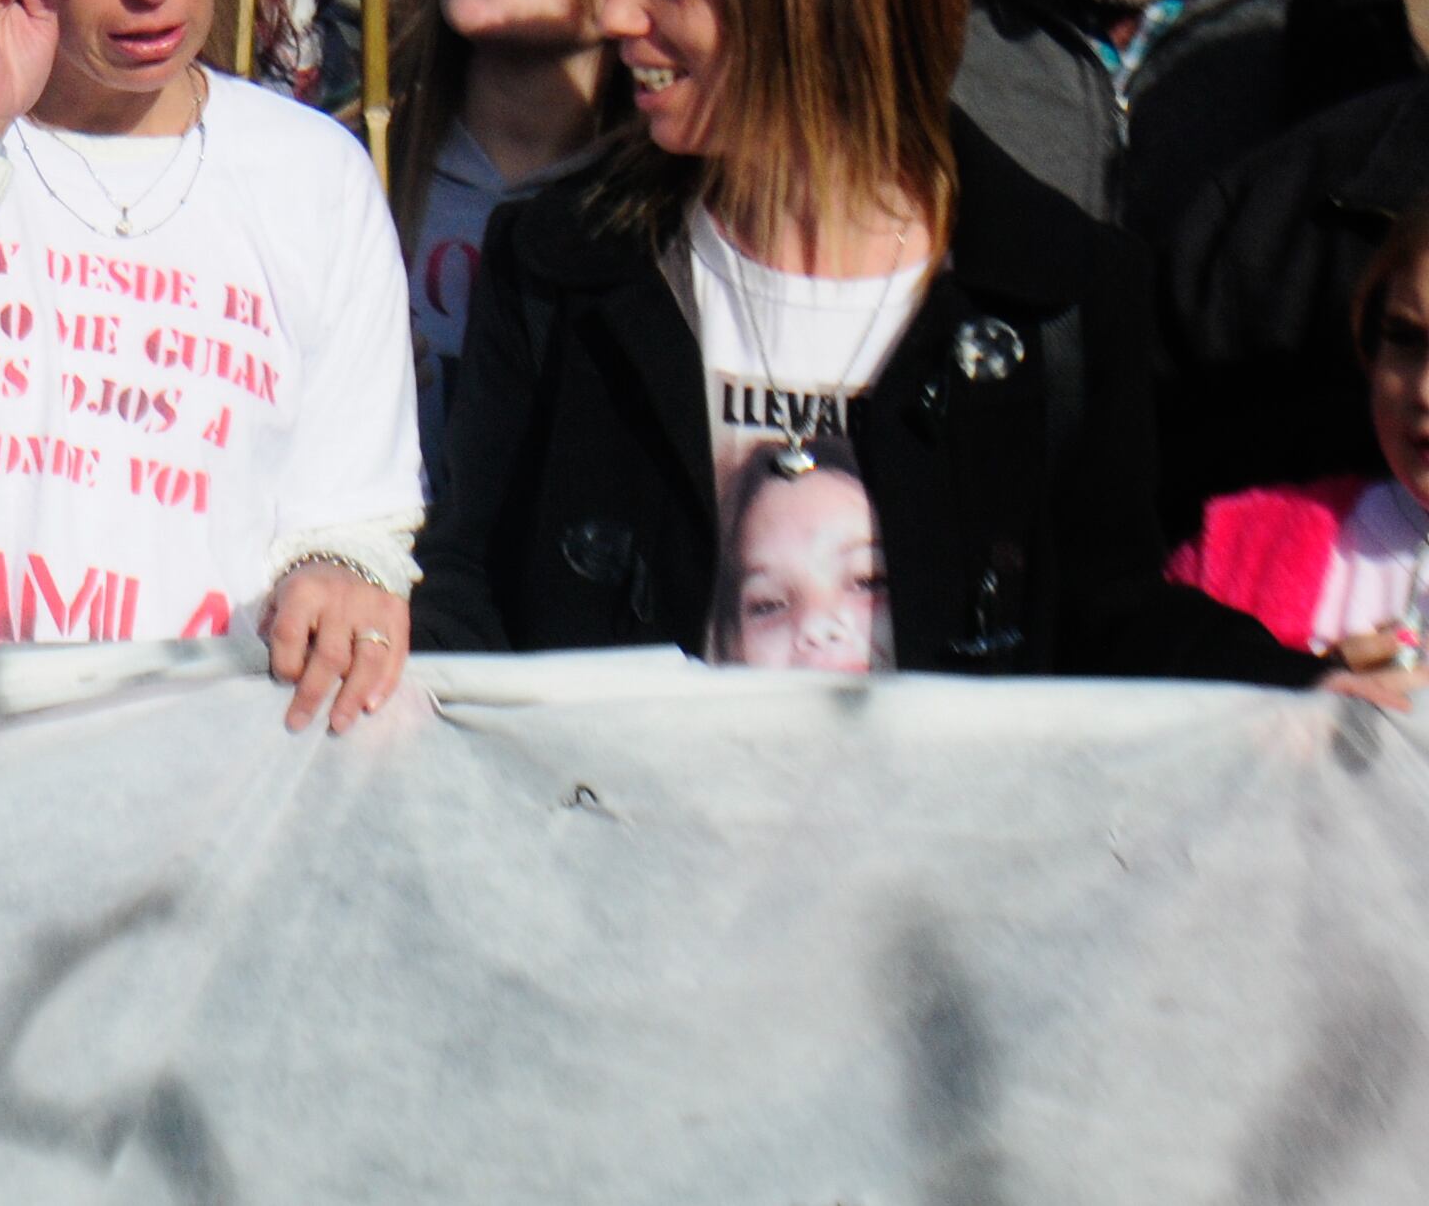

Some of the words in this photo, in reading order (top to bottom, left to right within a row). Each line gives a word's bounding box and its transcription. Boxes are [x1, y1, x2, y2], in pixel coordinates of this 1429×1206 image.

[46, 246, 199, 310] DESDE
[223, 282, 272, 338] EL
[144, 326, 281, 407] GUIAN
